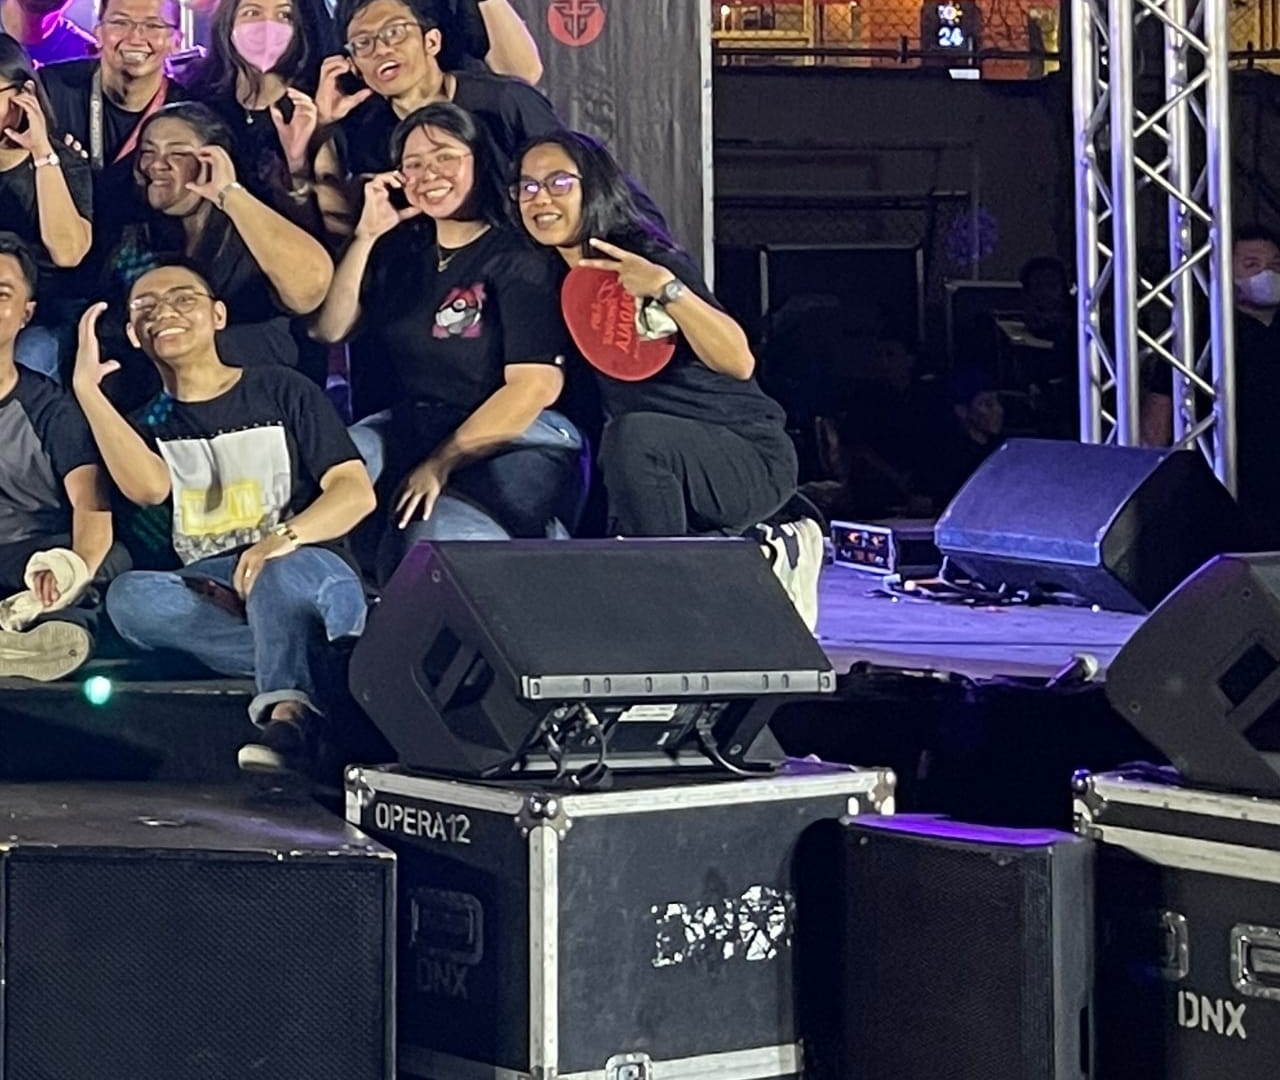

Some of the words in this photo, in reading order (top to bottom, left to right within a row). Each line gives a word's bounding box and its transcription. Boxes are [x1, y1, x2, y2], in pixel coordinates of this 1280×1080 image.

[938, 27, 964, 47] 24
[375, 802, 471, 844] OPERA12
[1177, 990, 1247, 1039] DNX
